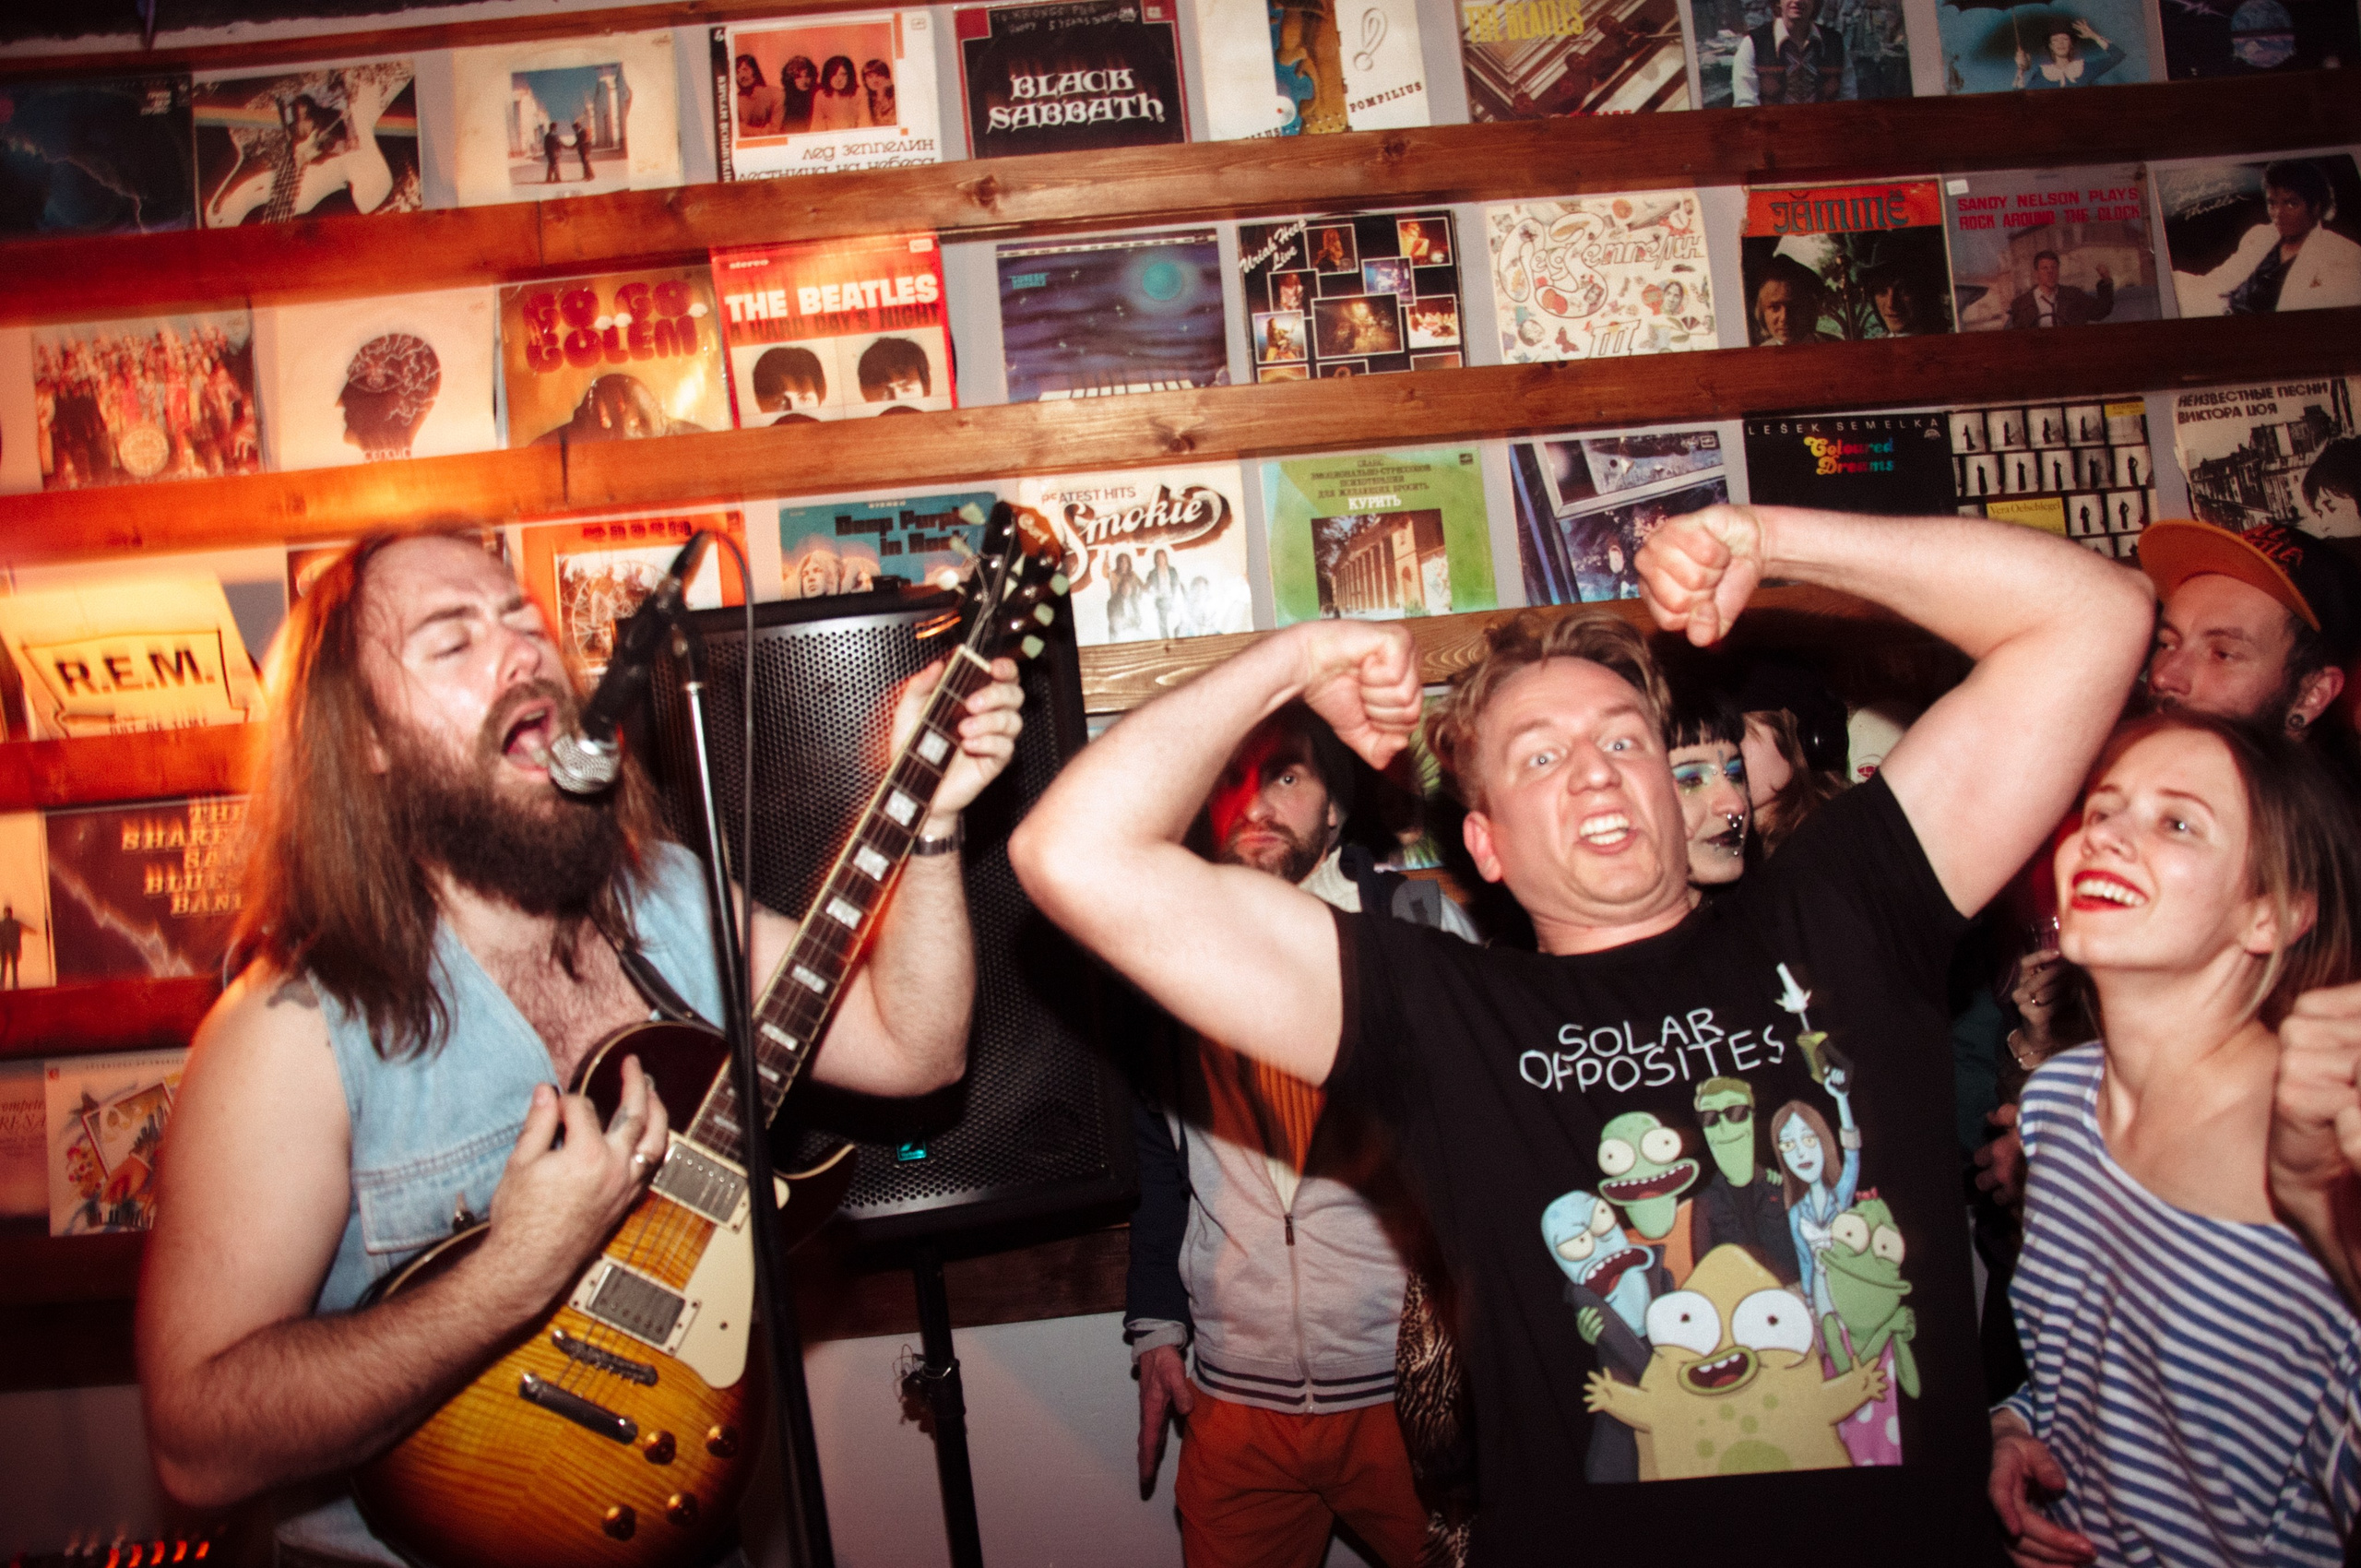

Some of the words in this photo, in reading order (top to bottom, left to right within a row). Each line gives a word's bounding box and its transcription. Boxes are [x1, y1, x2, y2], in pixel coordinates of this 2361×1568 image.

[1465, 4, 1503, 43] THE
[1504, 0, 1585, 41] BEATLES
[1010, 68, 1135, 101] BLACK
[1348, 80, 1423, 113] POMPILIUS
[1957, 196, 2008, 212] SANDY
[2017, 191, 2080, 208] NELSON
[2089, 187, 2139, 203] PLAYS
[1959, 214, 1995, 231] ROCK
[2003, 210, 2056, 229] AROUND
[2064, 208, 2088, 223] THE
[2098, 204, 2140, 221] CLOCK
[1239, 236, 1278, 274] Uriah
[1273, 219, 1308, 245] Heep
[1272, 245, 1299, 272] Live
[729, 259, 769, 270] stereo
[724, 289, 789, 323] THE
[797, 273, 940, 316] BEATLES
[749, 317, 806, 339] HARD
[878, 303, 941, 328] NIGHT
[2177, 386, 2274, 409] НЕИЗВЕСТНЫЕ
[2276, 381, 2330, 399] ПЕСНИ
[1748, 422, 1821, 436] LEŠEK
[1835, 417, 1940, 433] SEMELKA
[2177, 406, 2243, 425] ВИКТОРА
[2246, 402, 2278, 417] ЦОЯ
[1803, 435, 1894, 458] Coloured
[1816, 455, 1894, 476] Dreams
[1104, 486, 1136, 500] HITS
[1347, 494, 1402, 510] КУРИТЬ
[1990, 505, 2010, 516] Vera
[1059, 483, 1232, 576] Smokie
[55, 648, 216, 698] R.E.M.
[1559, 1006, 1725, 1062] SOLAR
[1519, 1025, 1786, 1094] OPPOSITES
